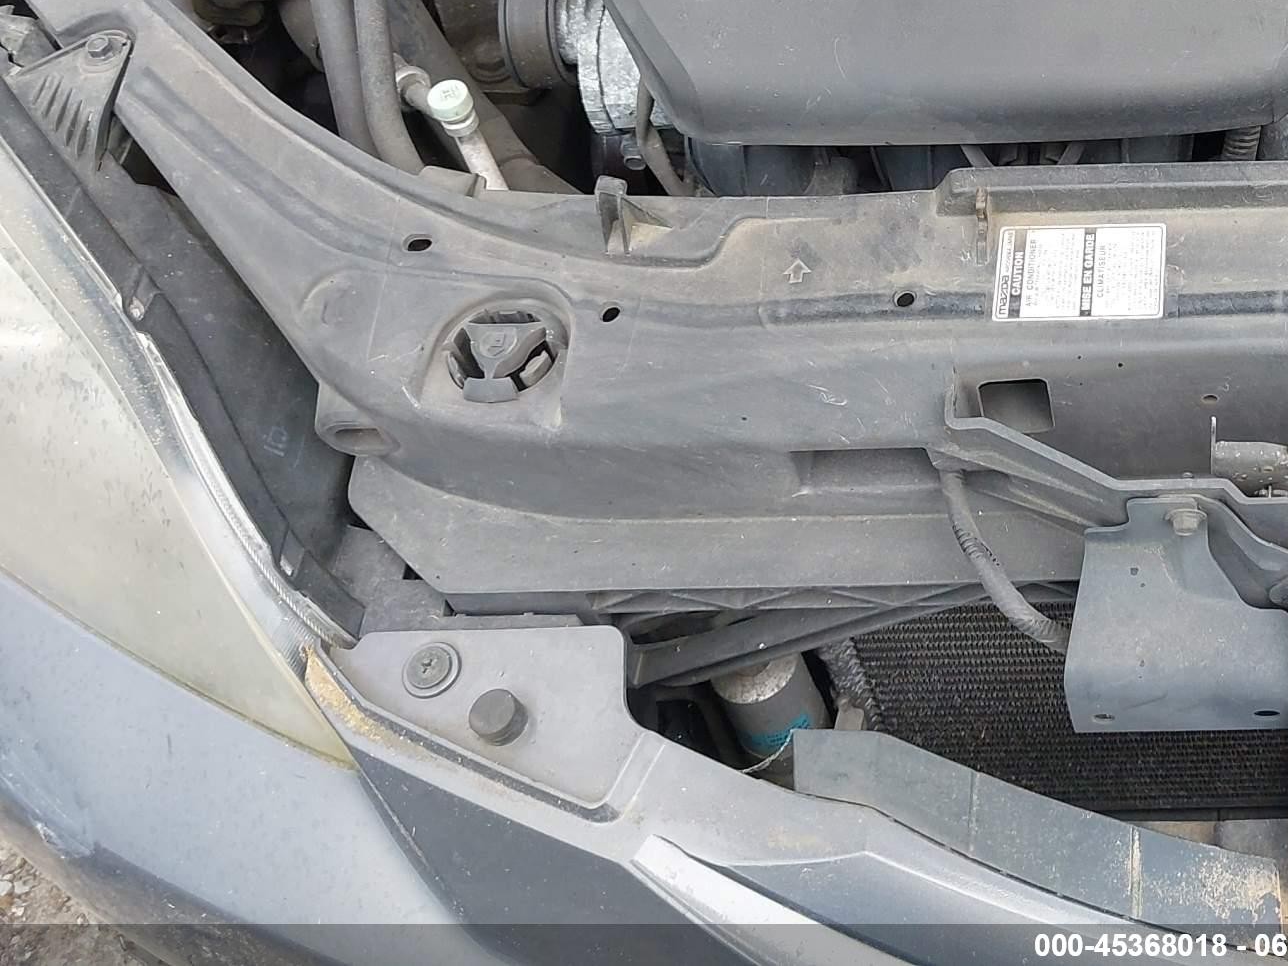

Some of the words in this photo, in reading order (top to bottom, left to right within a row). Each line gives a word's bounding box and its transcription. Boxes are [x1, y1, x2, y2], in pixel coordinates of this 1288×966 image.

[1026, 239, 1037, 291] CONDITIONER
[1083, 233, 1096, 268] GARDE
[1011, 251, 1025, 296] CAUTION
[1082, 269, 1093, 284] EN
[1096, 245, 1106, 298] CLIMATISEUR
[998, 275, 1010, 315] mazda
[1025, 294, 1033, 307] AIR
[1080, 285, 1093, 311] MISE
